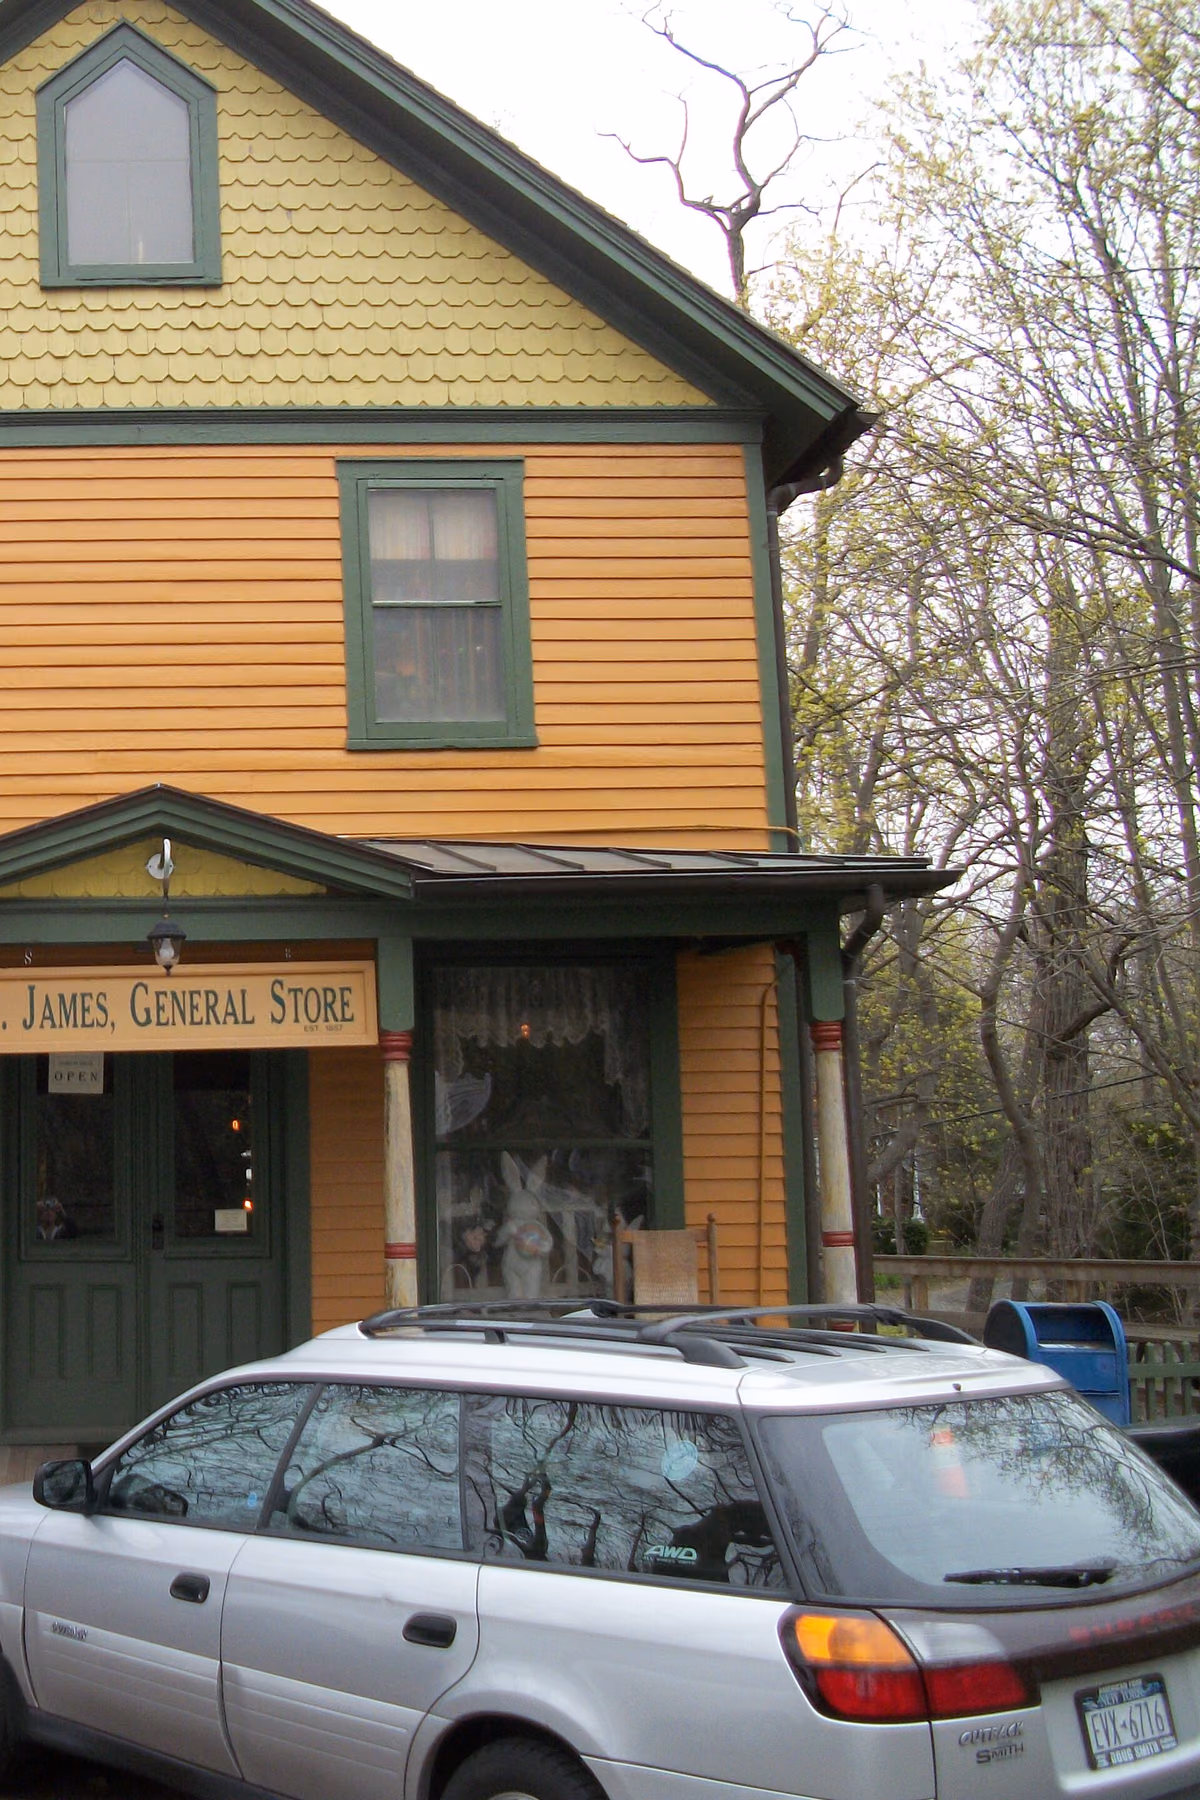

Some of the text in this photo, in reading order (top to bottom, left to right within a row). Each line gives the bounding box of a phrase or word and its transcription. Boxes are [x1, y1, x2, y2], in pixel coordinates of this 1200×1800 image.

[21, 984, 116, 1035] JAMES,
[129, 981, 256, 1028] GENERAL
[270, 978, 355, 1025] STORE
[53, 1070, 98, 1082] OPEN
[644, 1544, 698, 1560] AWD
[974, 1744, 1025, 1765] SMITH
